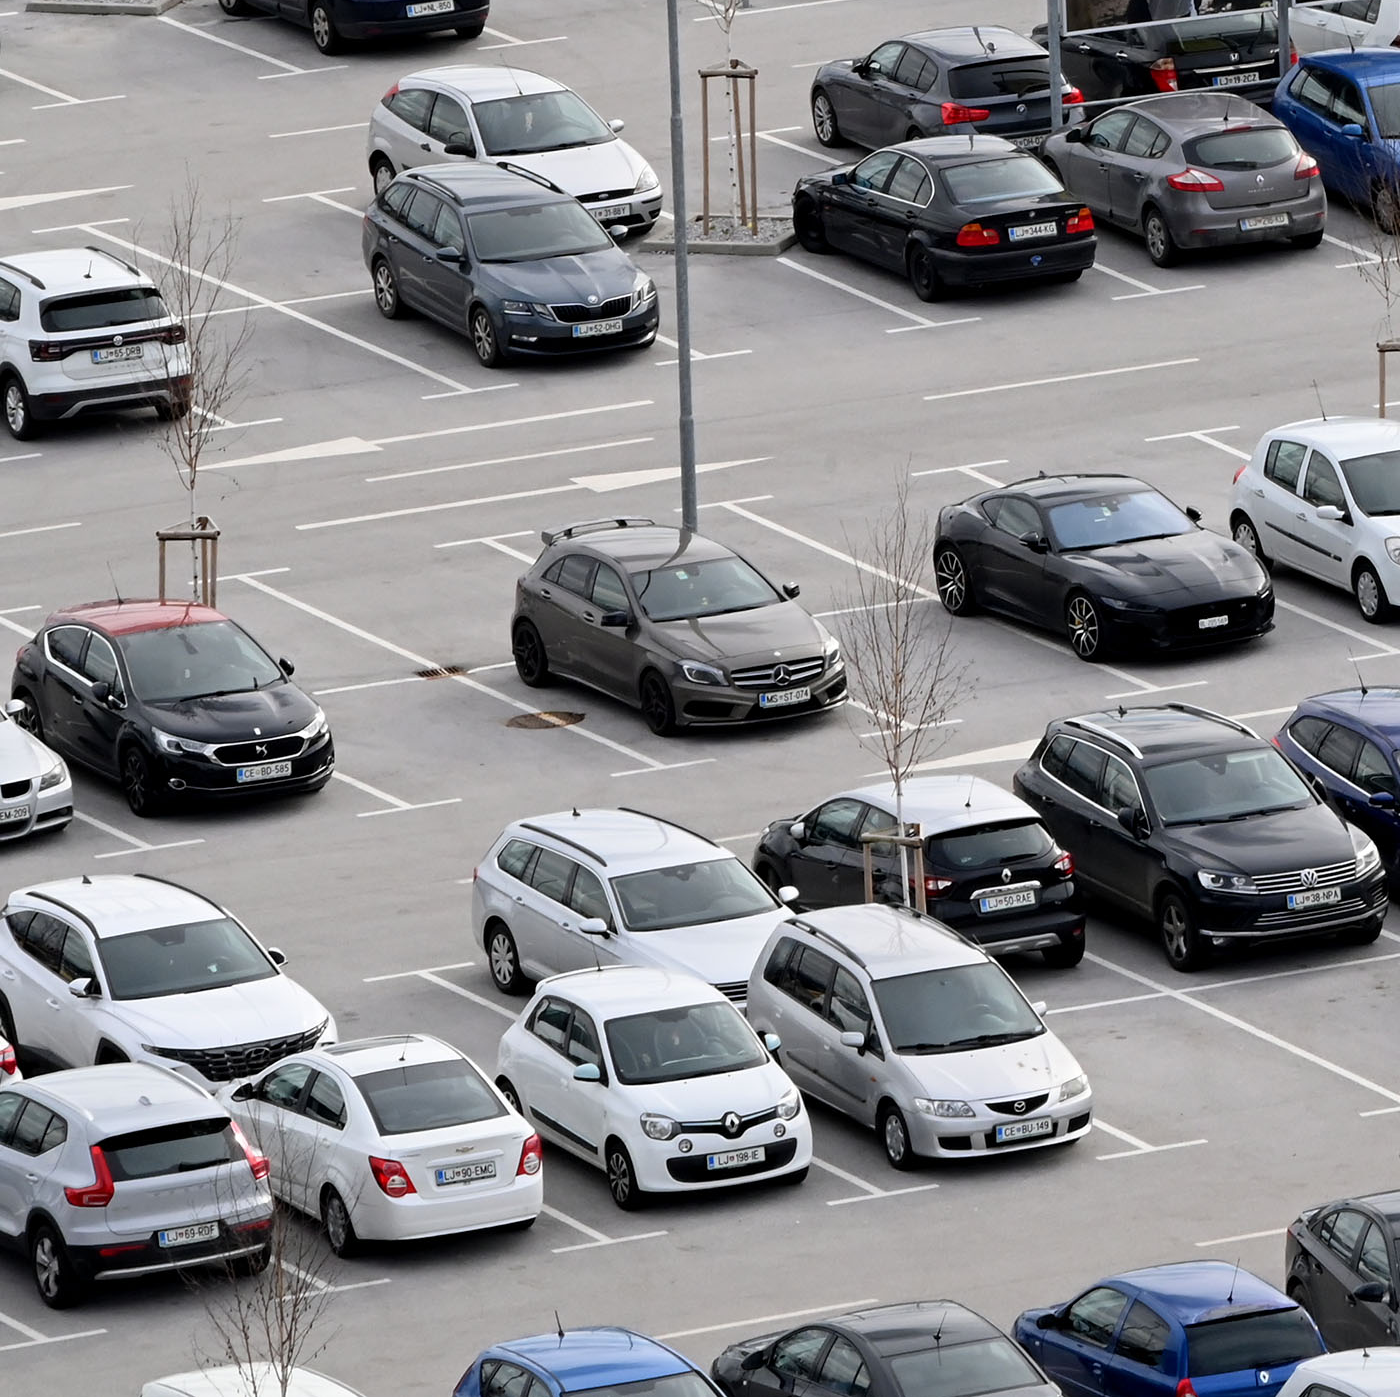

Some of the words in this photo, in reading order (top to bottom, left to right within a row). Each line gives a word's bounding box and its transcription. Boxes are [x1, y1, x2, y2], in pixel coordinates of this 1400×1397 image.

[1030, 225, 1055, 236] 344-KG
[784, 689, 809, 701] ST-074
[262, 764, 289, 775] BD-585
[1004, 894, 1031, 905] 50-RAE
[1311, 891, 1338, 902] 38-NPA
[1021, 1121, 1049, 1134] BU-149
[736, 1151, 759, 1162] 198-IE
[462, 1165, 493, 1177] 90-EMC
[185, 1226, 214, 1239] 69-RDF
